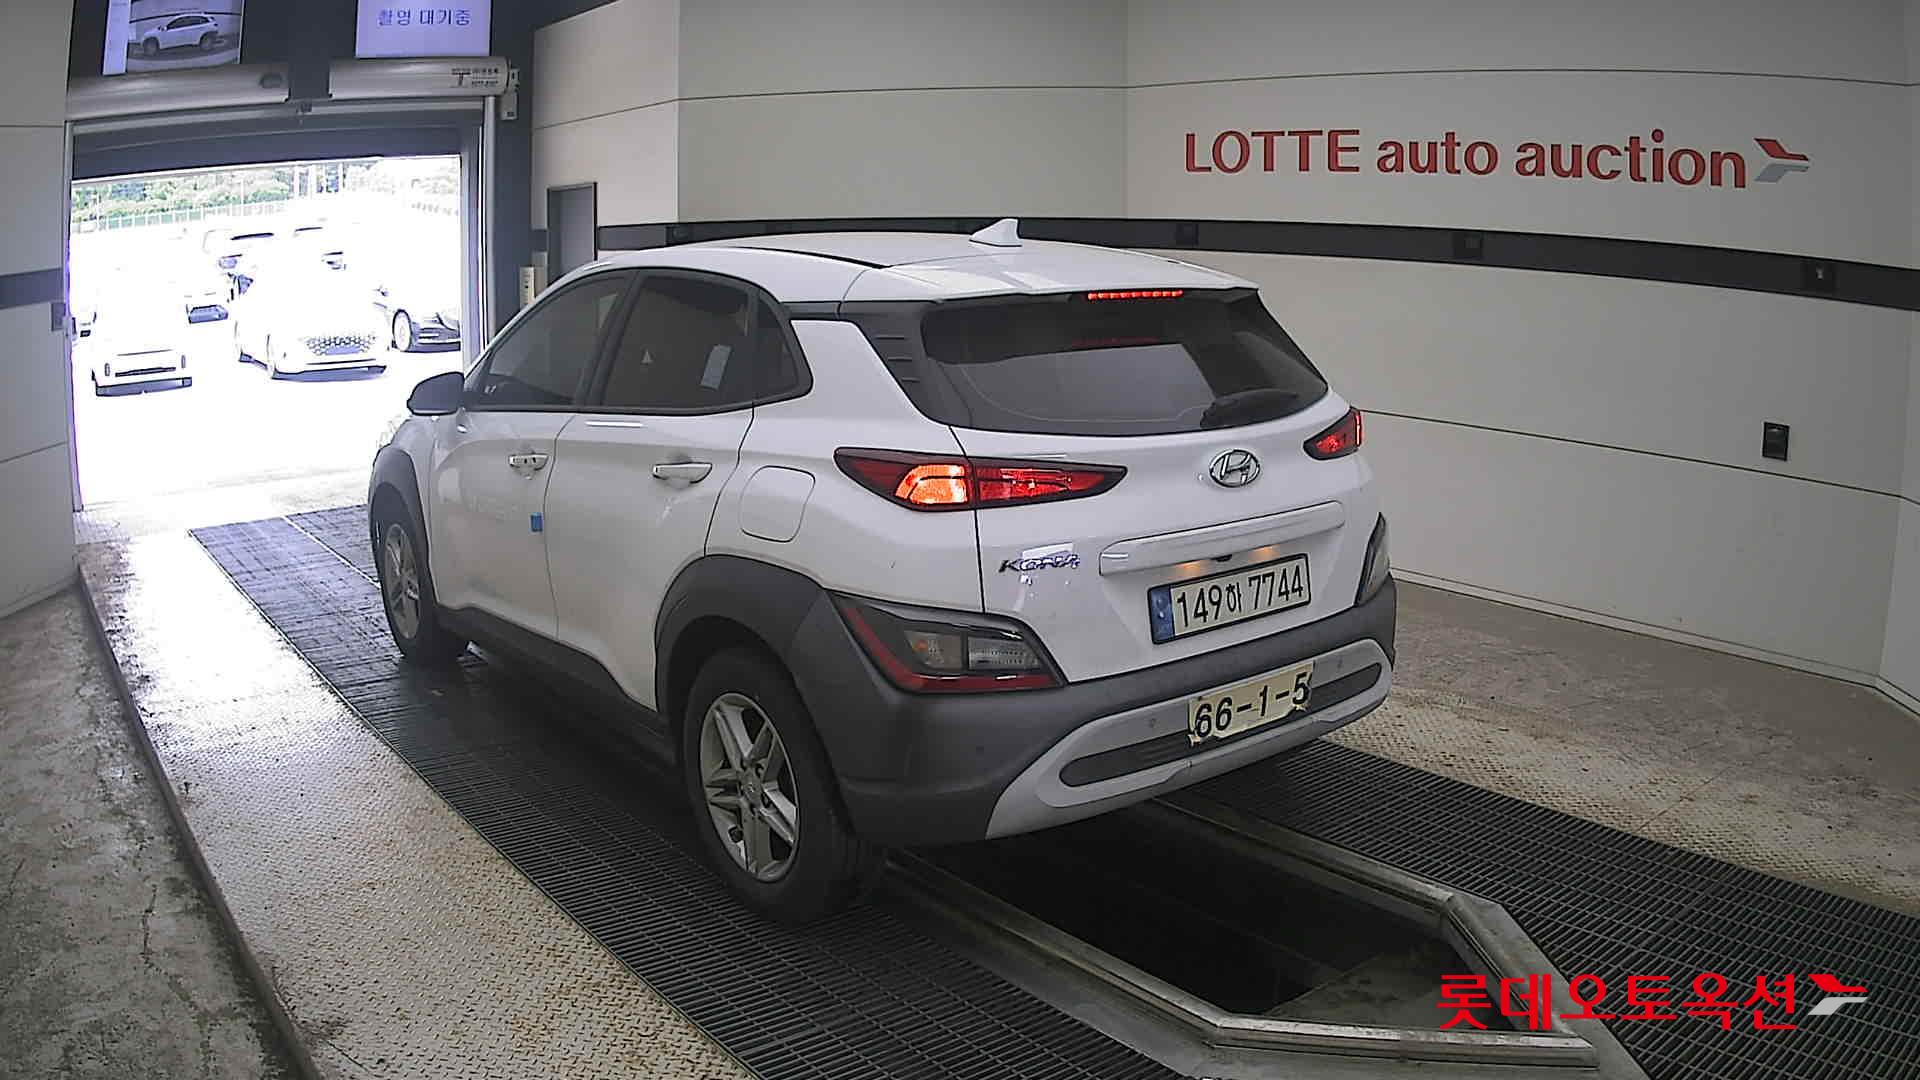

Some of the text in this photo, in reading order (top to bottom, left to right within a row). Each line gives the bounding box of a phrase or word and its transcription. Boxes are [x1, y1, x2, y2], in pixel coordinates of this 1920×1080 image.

[1185, 128, 1746, 188] LOTTE auto auction
[1176, 565, 1304, 628] 149하 7744
[1194, 671, 1313, 738] 66-1-5
